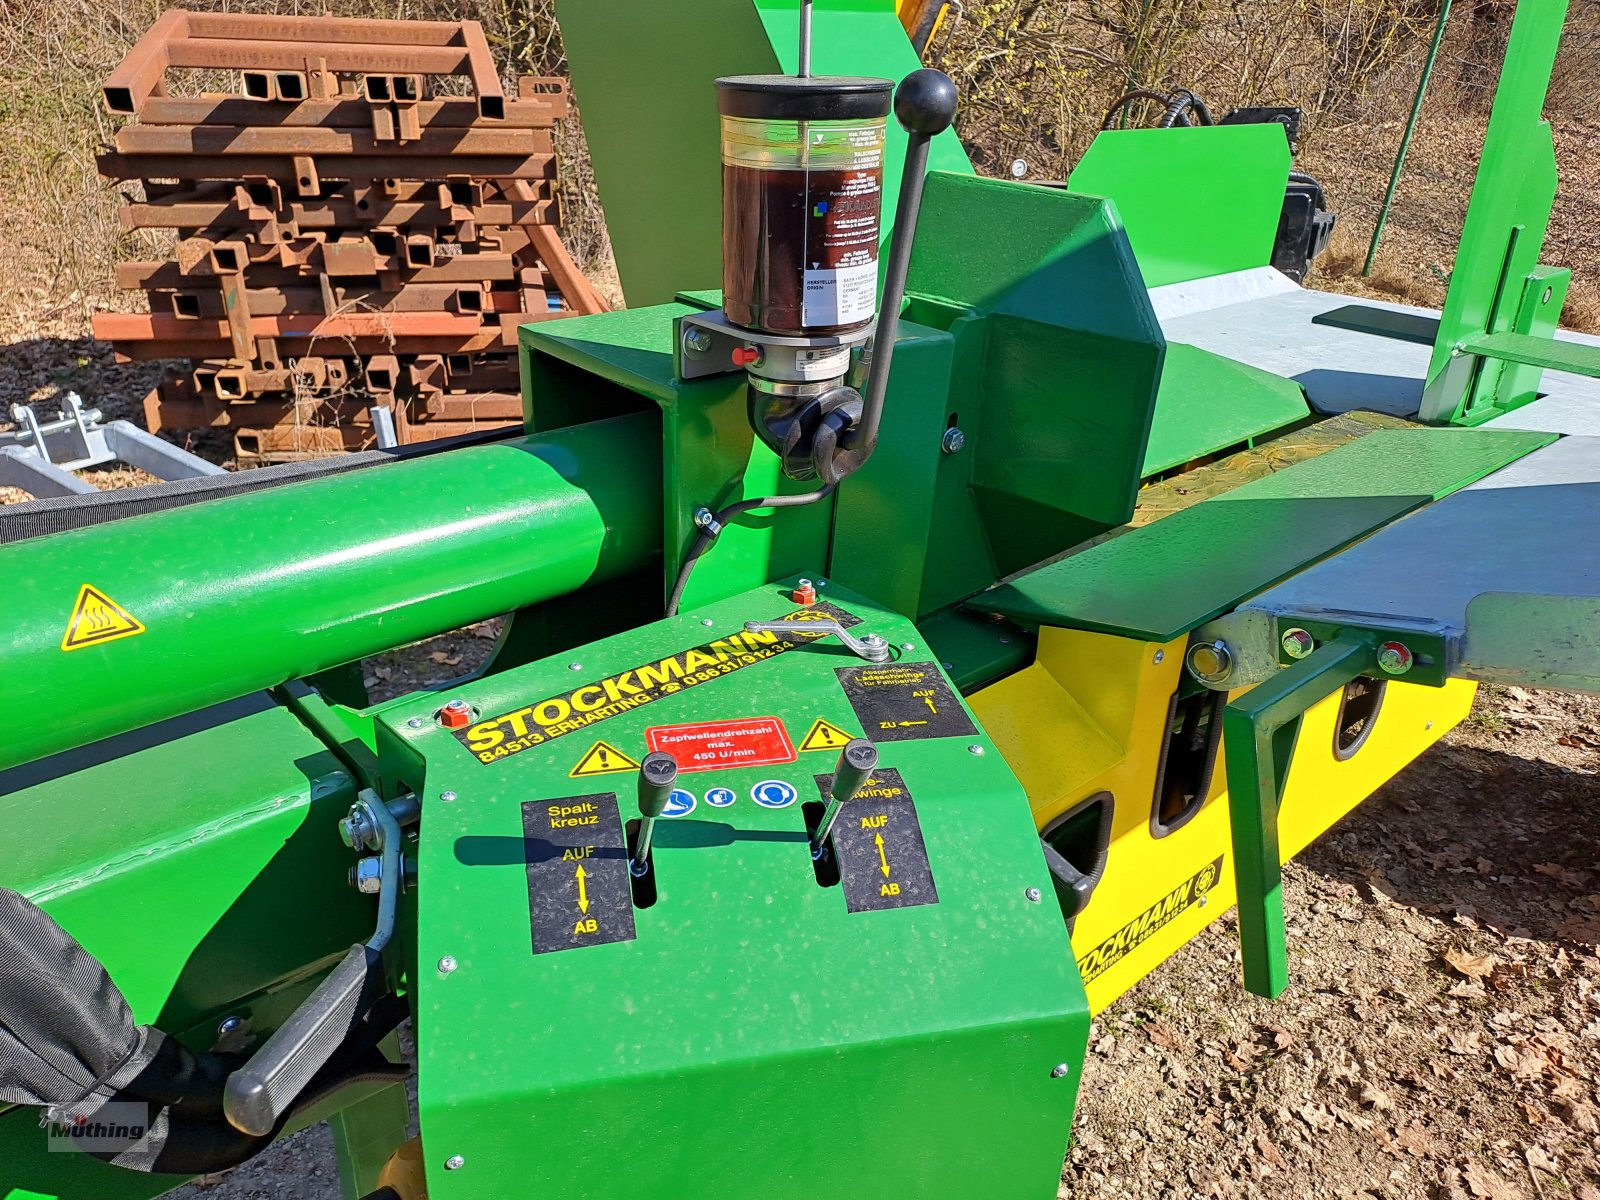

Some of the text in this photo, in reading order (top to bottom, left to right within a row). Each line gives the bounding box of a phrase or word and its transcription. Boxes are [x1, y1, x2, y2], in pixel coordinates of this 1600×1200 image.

[855, 672, 926, 682] Ladeschwinge
[467, 630, 779, 751] STOCKMANN
[913, 689, 935, 697] AUF
[478, 641, 795, 763] 84513 ERHARTING 08631/91234
[661, 726, 772, 743] Zapfwellendrehzahl
[693, 748, 756, 760] 450 U/min
[548, 802, 599, 817] Spalt-
[551, 815, 599, 828] kreuz
[861, 815, 888, 829] AUF
[562, 846, 595, 861] AUF
[881, 883, 900, 897] AB
[574, 919, 598, 935] AB
